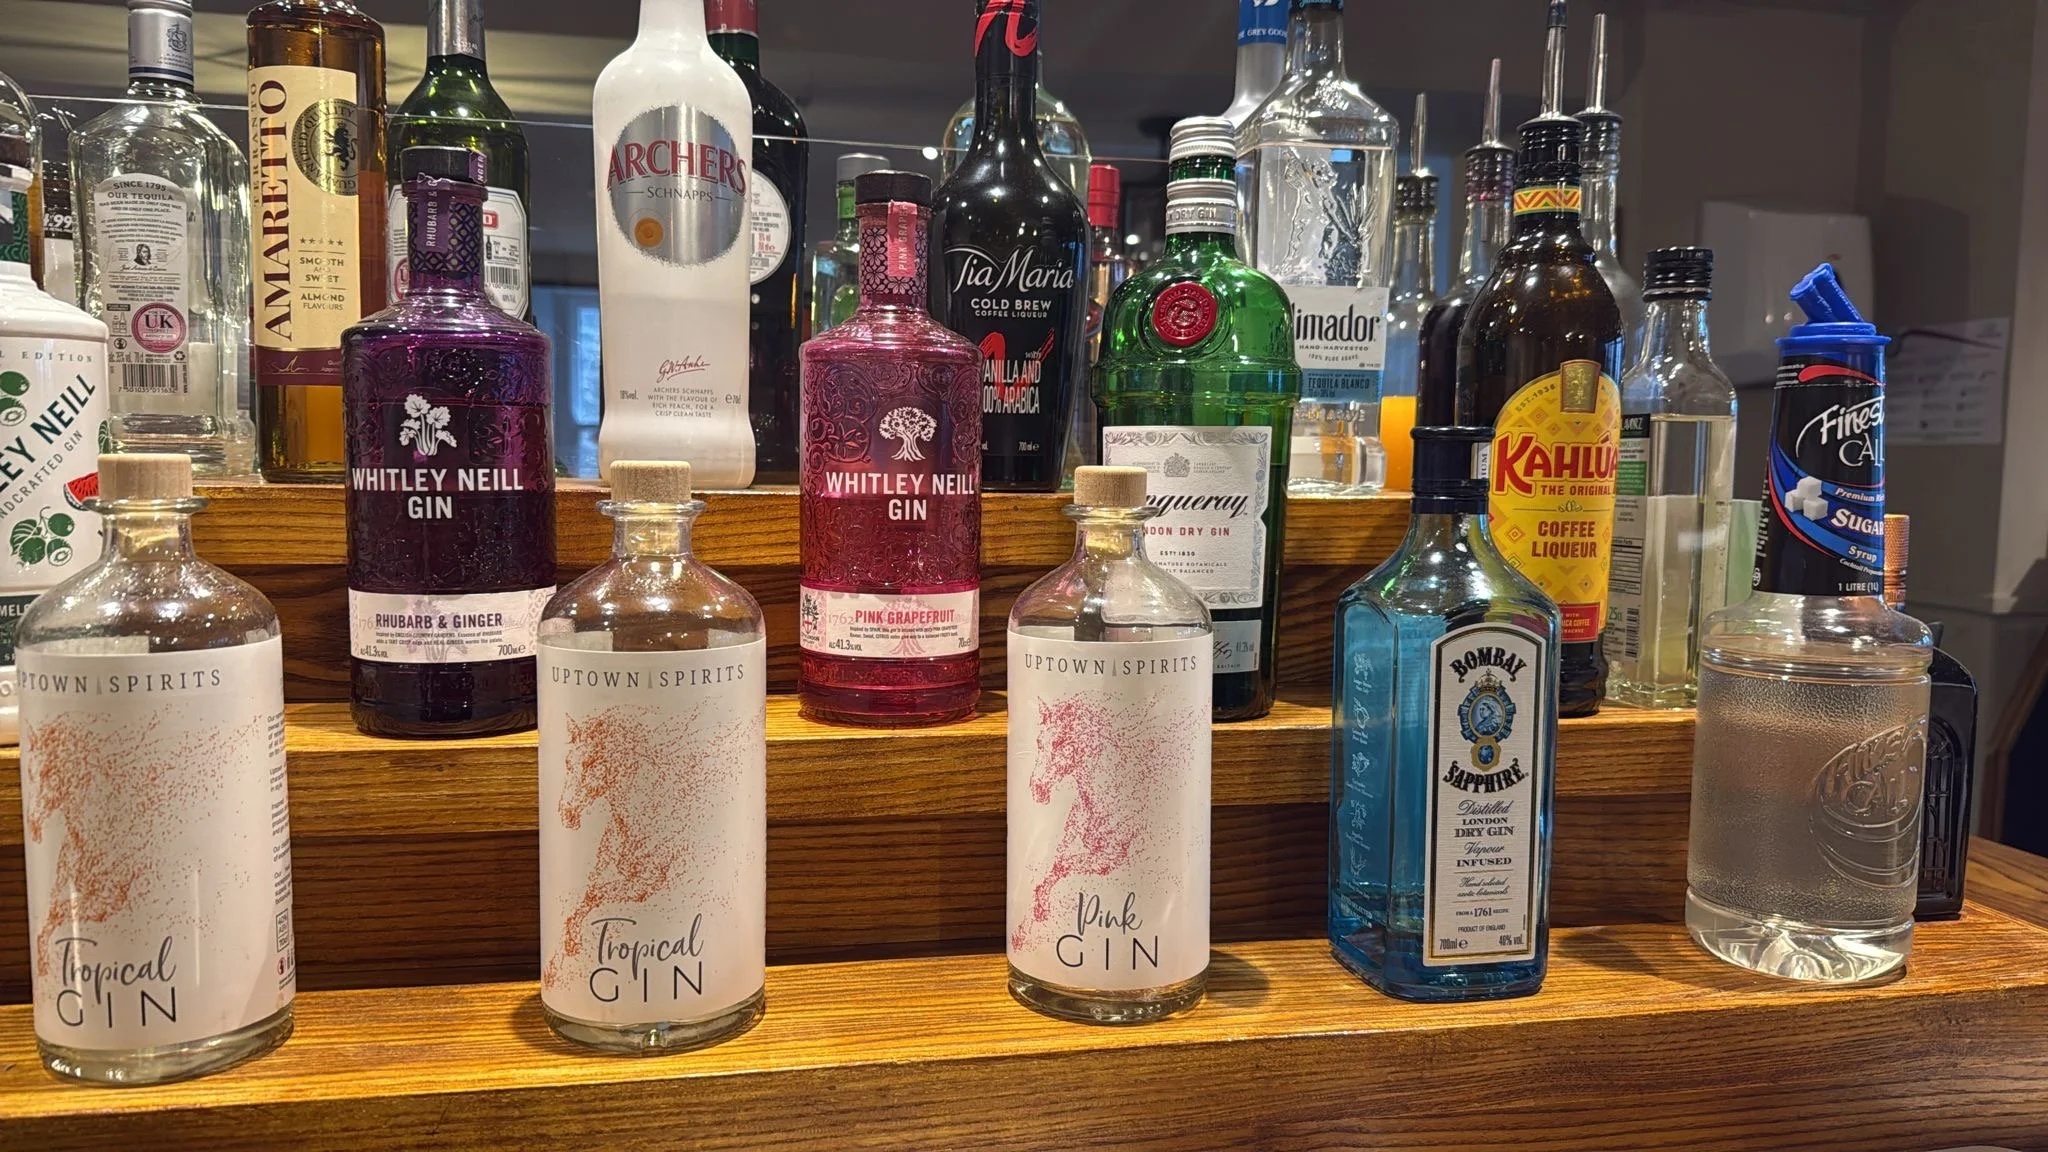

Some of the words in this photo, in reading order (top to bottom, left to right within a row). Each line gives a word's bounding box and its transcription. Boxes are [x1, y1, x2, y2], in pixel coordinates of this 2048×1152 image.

[1247, 28, 1266, 36] GREY
[1268, 28, 1288, 38] GOOS
[607, 139, 747, 197] ARCHERS
[113, 181, 143, 189] SINCE
[145, 182, 167, 191] 1795
[647, 187, 713, 202] SCHNAPPS
[258, 80, 292, 342] AMARETTO
[1198, 207, 1217, 219] GIN
[426, 201, 438, 247] RHUBARB
[898, 246, 908, 270] PINK
[945, 247, 1000, 293] Tia
[986, 248, 1074, 294] Maria
[301, 293, 345, 302] ALMOND
[971, 299, 1010, 310] COLD
[1015, 300, 1052, 311] BREW
[144, 314, 173, 329] UK
[22, 351, 92, 363] EDITION
[983, 360, 1018, 384] ANILLA
[1022, 360, 1041, 384] AND
[1308, 378, 1338, 389] TEQUILA
[1341, 378, 1370, 390] BLANCO
[983, 386, 1000, 414] 00%
[1003, 386, 1040, 414] ARABICA
[31, 374, 96, 444] NEILL
[1806, 395, 1885, 450] Finest
[0, 456, 64, 518] NDCRAFTED
[64, 429, 83, 452] GIN
[352, 468, 448, 492] WHITLEY
[458, 468, 524, 492] NEILL
[826, 472, 924, 495] WHITLEY
[932, 474, 974, 495] NEILL
[1542, 485, 1564, 496] THE
[1569, 486, 1611, 496] ORIGINAL
[1836, 488, 1875, 502] Premium
[408, 496, 452, 519] GIN
[888, 499, 927, 521] GIN
[1146, 494, 1248, 519] nqueray
[1144, 526, 1172, 536] NDON
[1180, 527, 1204, 536] DRY
[1211, 527, 1230, 536] GIN
[1538, 520, 1596, 538] COFFEE
[1532, 541, 1597, 558] LIQUEUR
[1848, 546, 1878, 562] Syrup
[1838, 583, 1842, 591] 1
[1846, 582, 1866, 592] LITRE
[376, 613, 432, 629] RHUBARB
[438, 615, 447, 628] &
[453, 613, 502, 628] GINGER
[855, 610, 884, 624] PINK
[888, 609, 955, 624] GRAPEFRUIT
[1024, 653, 1104, 675] UPTOWN
[1122, 655, 1196, 675] SPIRITS
[1450, 647, 1527, 683] BOMBAY
[17, 669, 88, 694] PTOWN
[109, 669, 222, 694] SPIRITS
[552, 666, 640, 688] UPTOWN
[660, 664, 744, 688] SPIRITS
[1443, 757, 1526, 794] SAPPHIRE
[1456, 799, 1514, 816] Distilled
[1462, 817, 1508, 826] LONDON
[1454, 826, 1484, 838] DRY
[1487, 826, 1514, 837] GIN
[1464, 842, 1504, 858] Vapour
[1456, 857, 1512, 868] INFUSED
[1460, 876, 1482, 888] Hand
[1482, 877, 1508, 886] selected
[1476, 886, 1510, 896] botanicals
[1077, 891, 1143, 936] Pink
[1474, 908, 1492, 917] 1761
[1486, 924, 1506, 932] ENGLAND
[591, 913, 704, 981] Tropical
[1499, 934, 1512, 946] 40%
[1056, 934, 1158, 970] GIN
[55, 935, 177, 1005] Tropical
[590, 961, 702, 1002] GIN
[57, 986, 177, 1028] GIN
